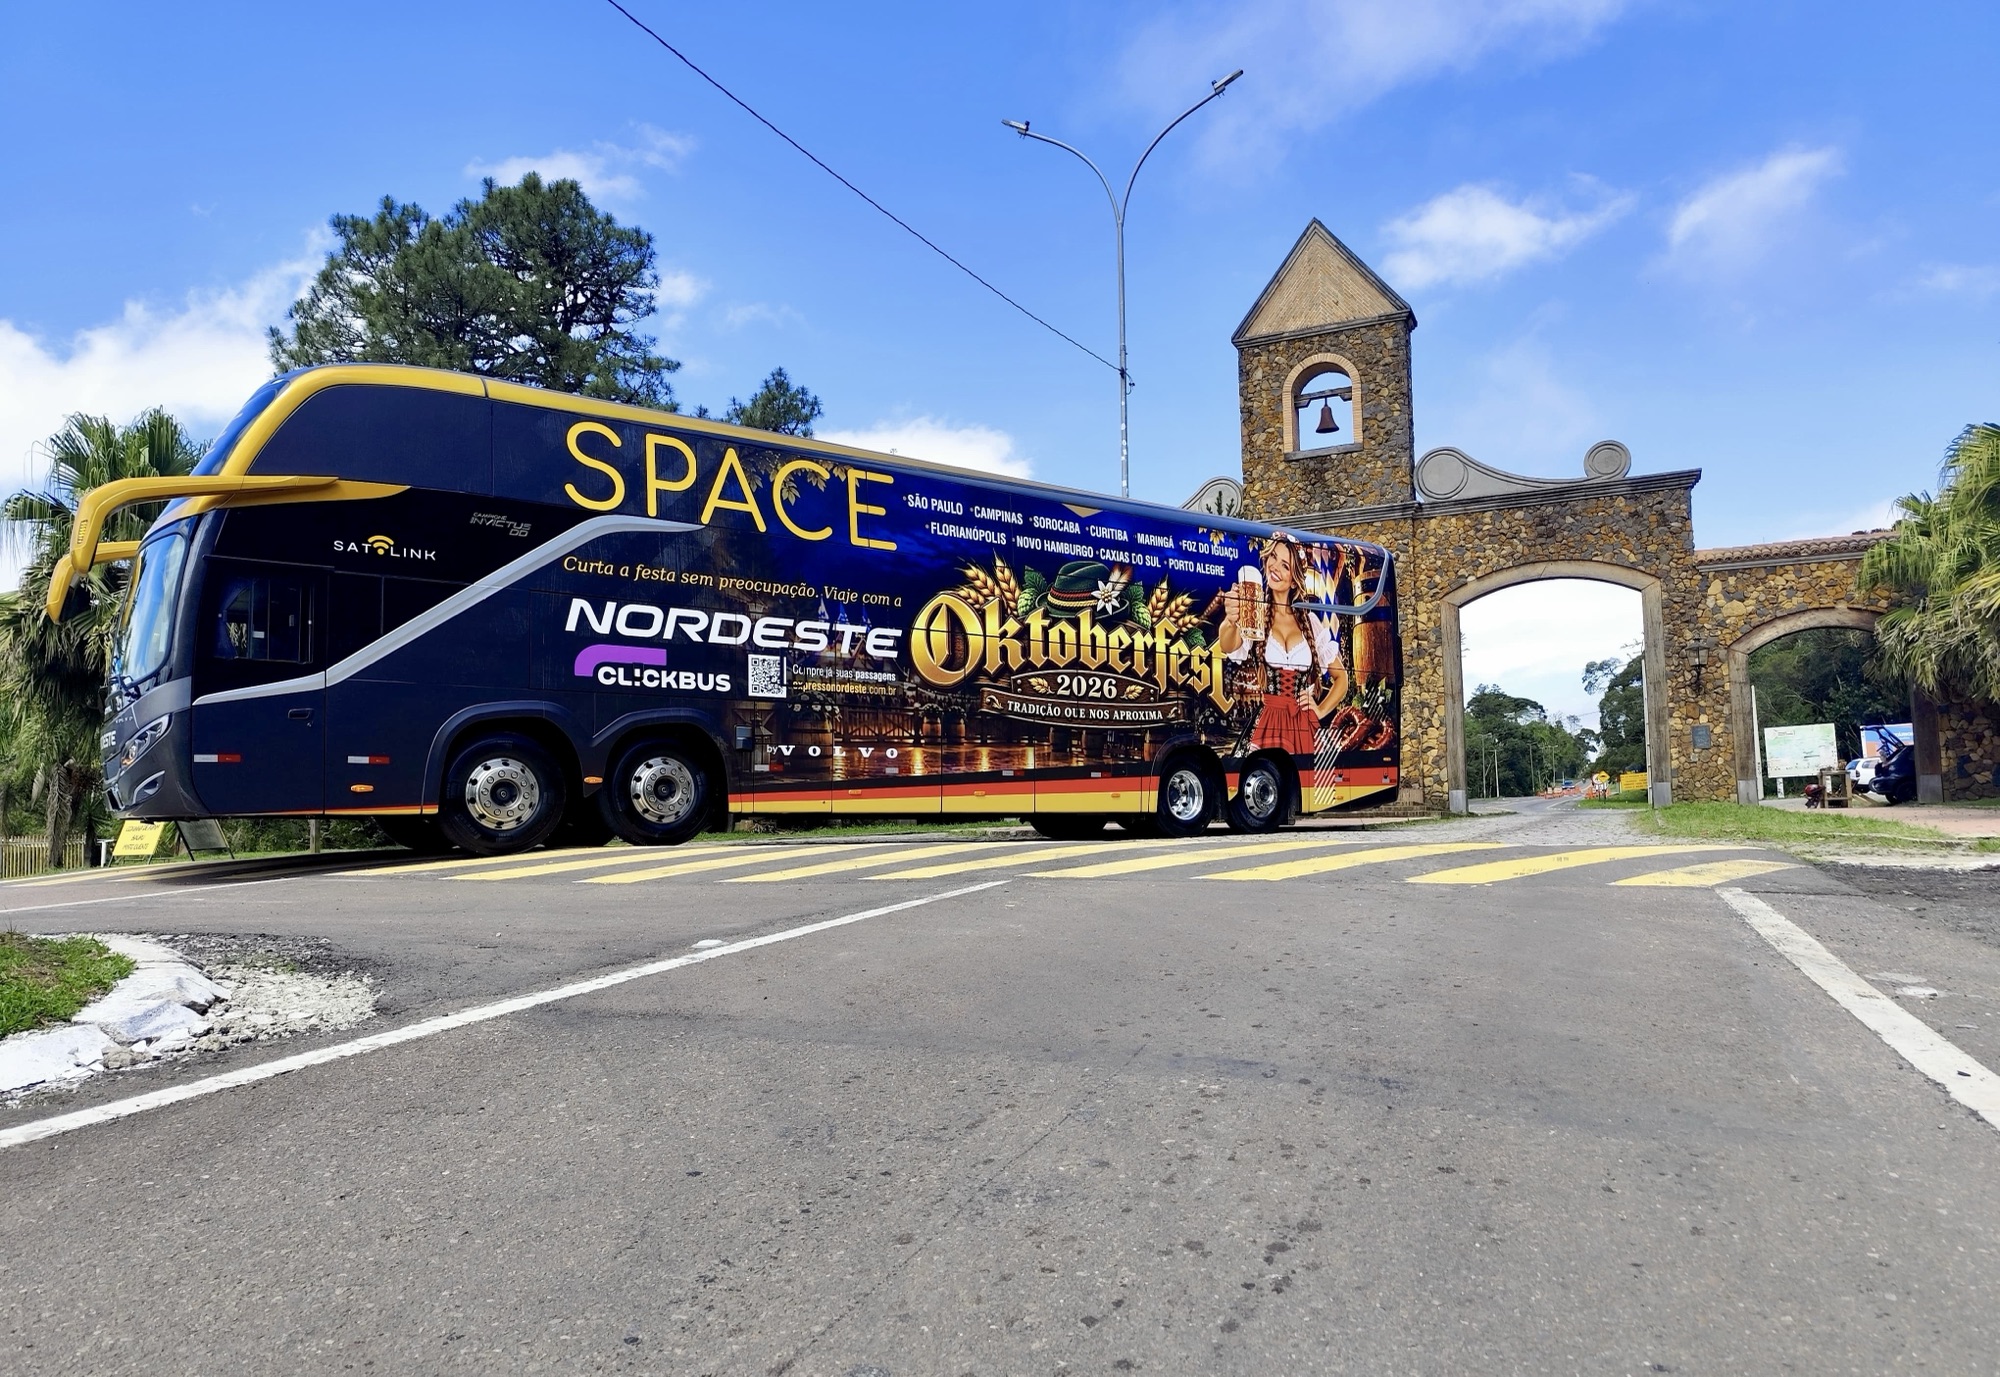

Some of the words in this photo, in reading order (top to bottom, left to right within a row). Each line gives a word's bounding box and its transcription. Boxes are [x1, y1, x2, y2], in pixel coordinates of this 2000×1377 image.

[564, 421, 897, 551] SPACE
[907, 493, 928, 510] SÃO
[930, 498, 964, 516] PAULO
[470, 516, 532, 531] INVICTUS
[974, 505, 1024, 526] CAMPINAS
[1033, 515, 1081, 535] SOROCABA
[509, 528, 529, 537] DD
[930, 521, 1007, 546] FLORIANÓPOLIS
[1089, 525, 1129, 542] CURITIBA
[1137, 532, 1175, 549] MARINGÁ
[333, 540, 372, 554] SAT
[390, 546, 437, 561] LINK
[1016, 535, 1042, 551] NOVO
[1043, 540, 1094, 558] HAMBURGO
[1181, 539, 1197, 553] FOZ
[1198, 543, 1210, 555] DO
[1211, 545, 1239, 561] IGUAÇU
[1100, 548, 1130, 564] CAXIAS
[1131, 553, 1143, 565] DO
[1145, 555, 1162, 568] SUL
[1168, 558, 1195, 573] PORTO
[1196, 562, 1226, 577] ALEGRE
[563, 556, 614, 576] Curta
[619, 565, 630, 577] a
[633, 564, 676, 582] festa
[680, 572, 714, 587] sem
[718, 576, 819, 599] preocupação.
[823, 585, 859, 605] Viaje
[862, 593, 890, 606] com
[894, 596, 903, 607] a
[565, 598, 903, 658] NORDESTE
[911, 592, 1236, 714] Oktoberfest
[597, 665, 732, 692] CLICKBUS
[825, 666, 834, 678] já
[836, 669, 853, 678] suas
[855, 671, 897, 682] passagens
[1056, 674, 1118, 699] 2026
[1007, 700, 1061, 717] TRADIÇÃO
[1089, 709, 1110, 720] NOS
[1112, 710, 1164, 721] APROXIMA
[766, 744, 778, 755] by
[778, 744, 899, 759] VOLVO
